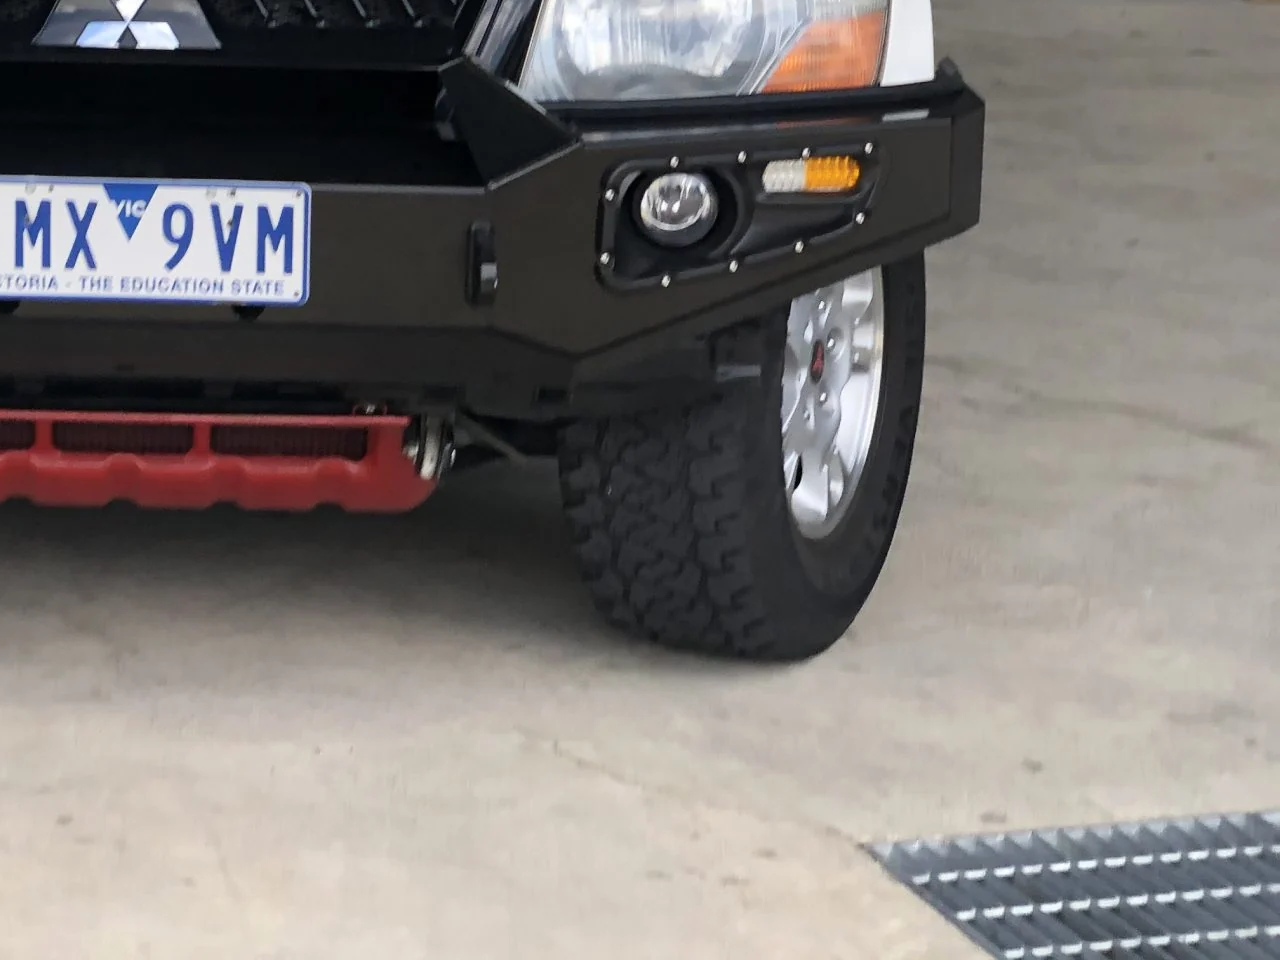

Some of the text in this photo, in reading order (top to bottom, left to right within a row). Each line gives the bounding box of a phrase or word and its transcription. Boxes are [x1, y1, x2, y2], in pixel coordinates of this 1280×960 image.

[116, 199, 147, 218] VIC
[162, 203, 295, 275] 9VM
[79, 276, 113, 292] THE
[120, 277, 223, 294] EDUCATION
[231, 279, 285, 296] STATE
